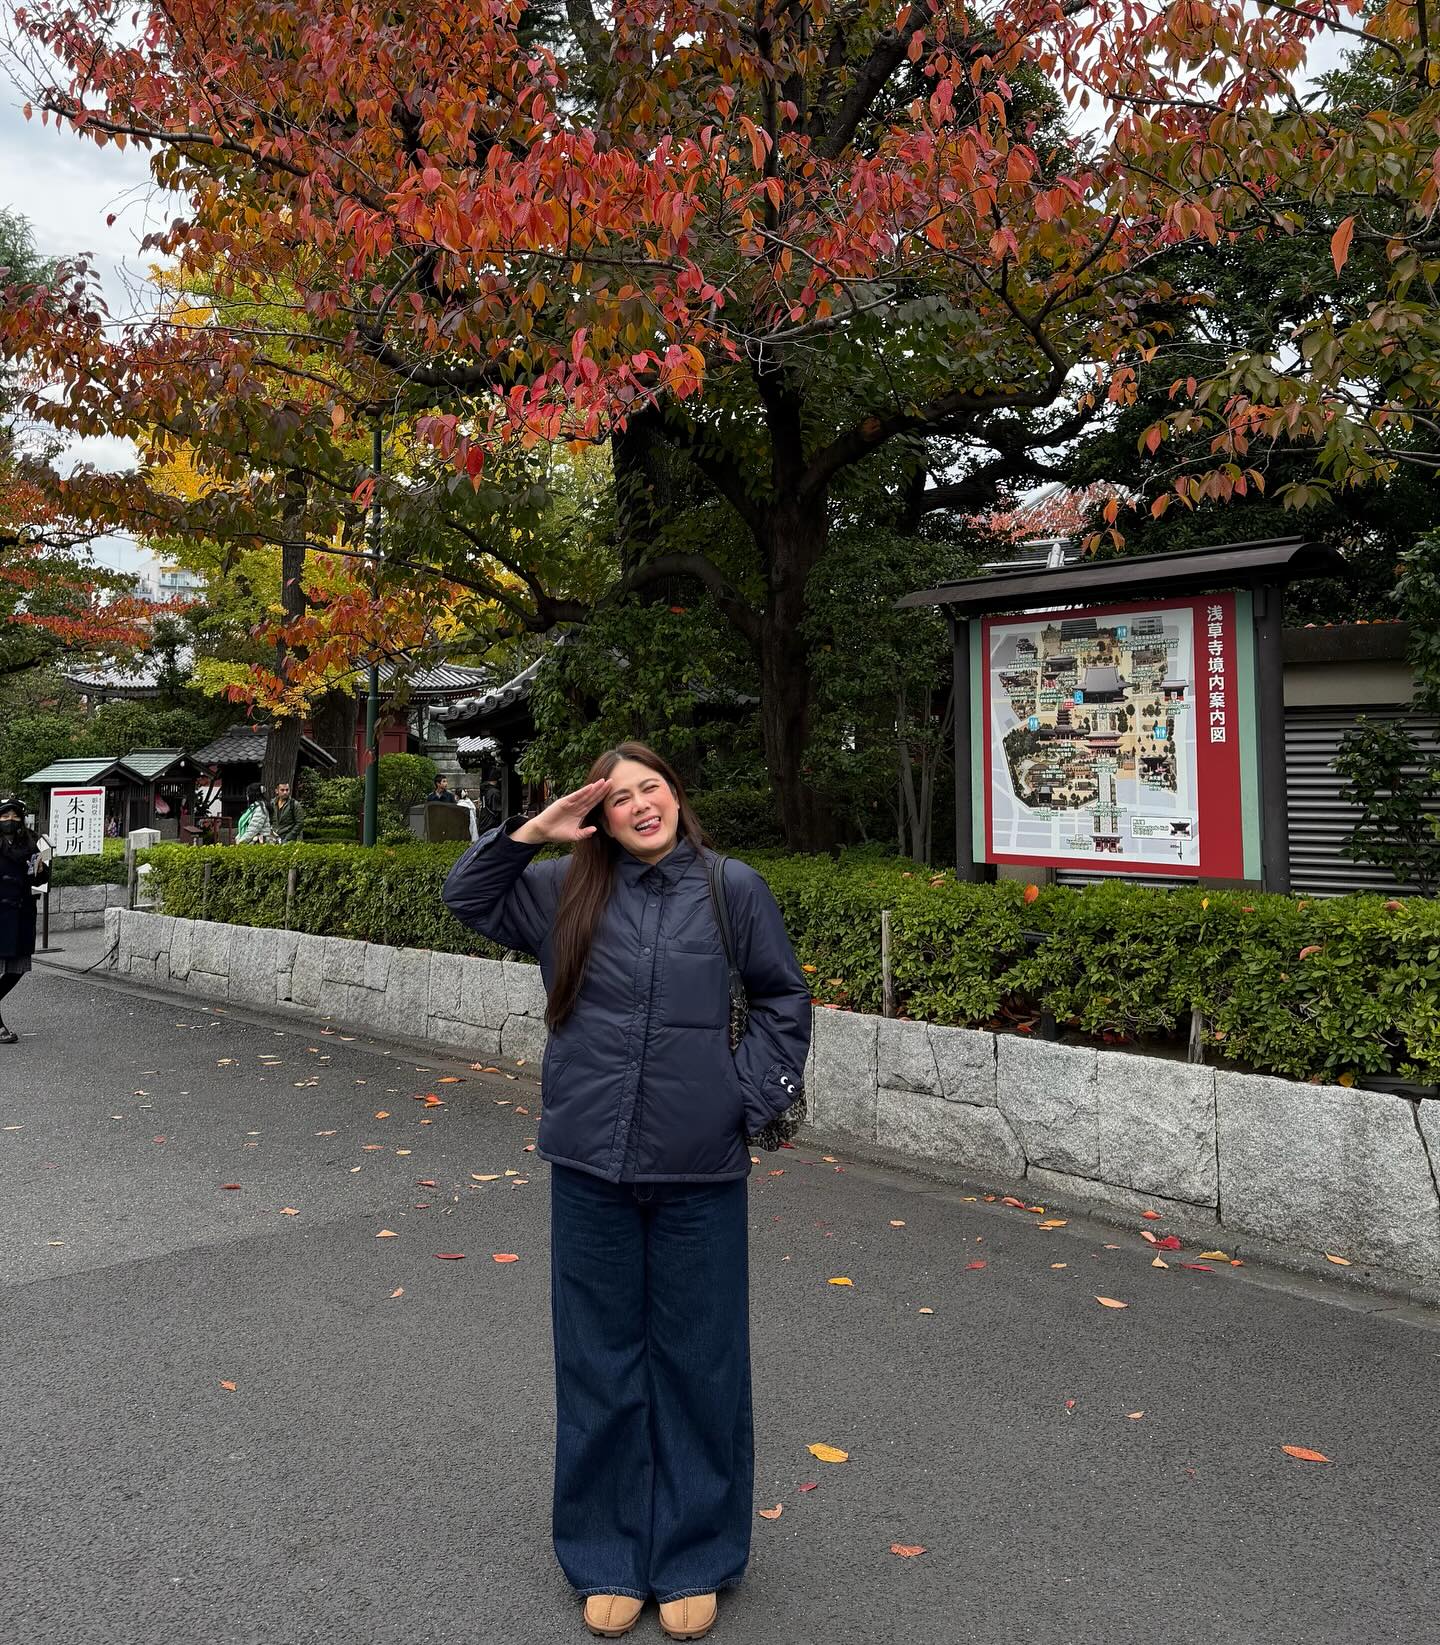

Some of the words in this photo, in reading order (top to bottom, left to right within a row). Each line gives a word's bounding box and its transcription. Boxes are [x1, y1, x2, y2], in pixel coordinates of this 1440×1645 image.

[1207, 605, 1226, 743] 浅草寺境内案内図
[65, 797, 85, 853] 朱印所
